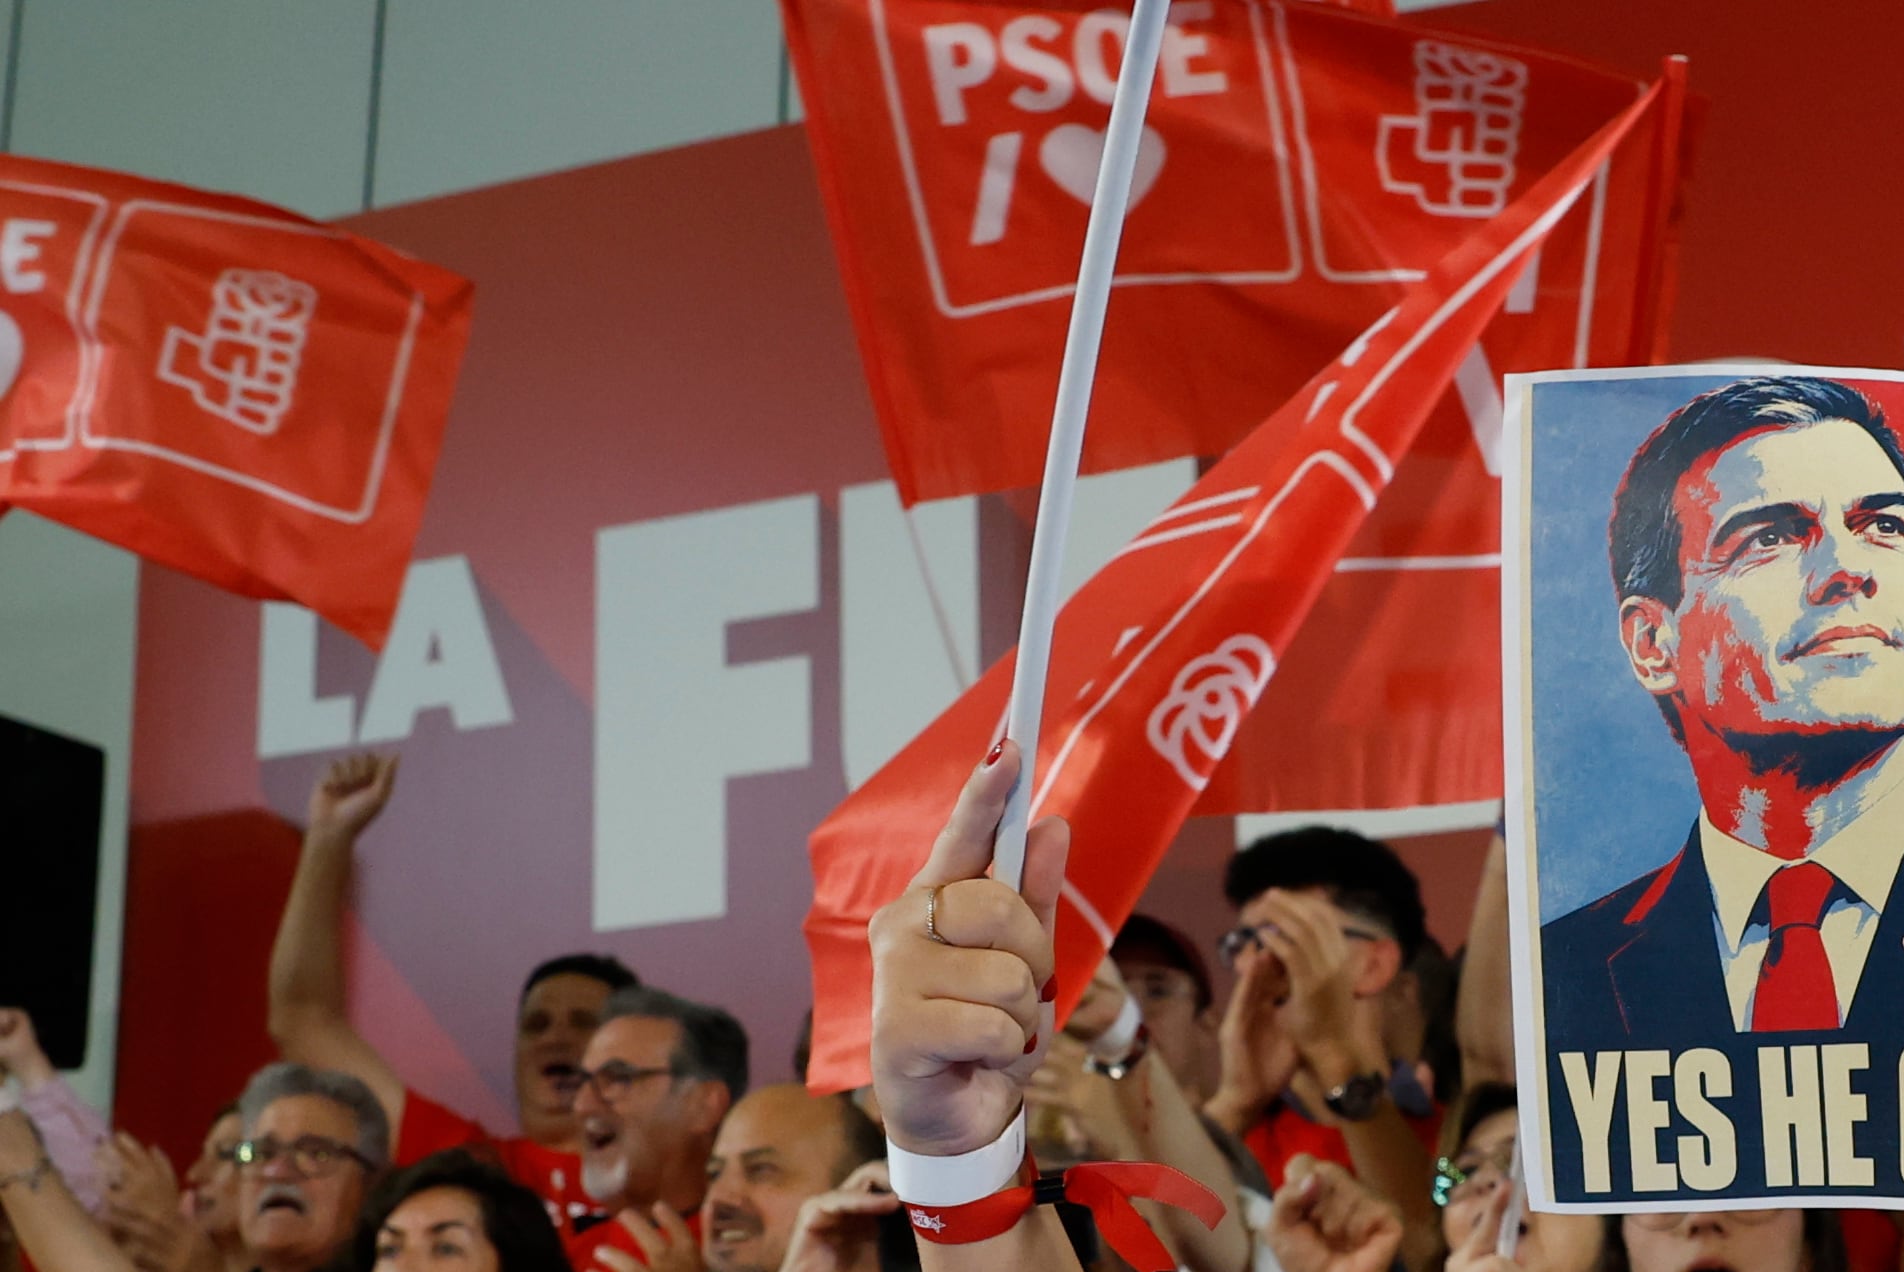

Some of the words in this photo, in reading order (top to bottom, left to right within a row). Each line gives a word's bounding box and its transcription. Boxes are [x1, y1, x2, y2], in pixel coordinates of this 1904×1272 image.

[922, 3, 1228, 126] PSOE
[257, 554, 516, 760] LA
[1558, 1047, 1737, 1193] YES
[1757, 1043, 1875, 1188] HE
